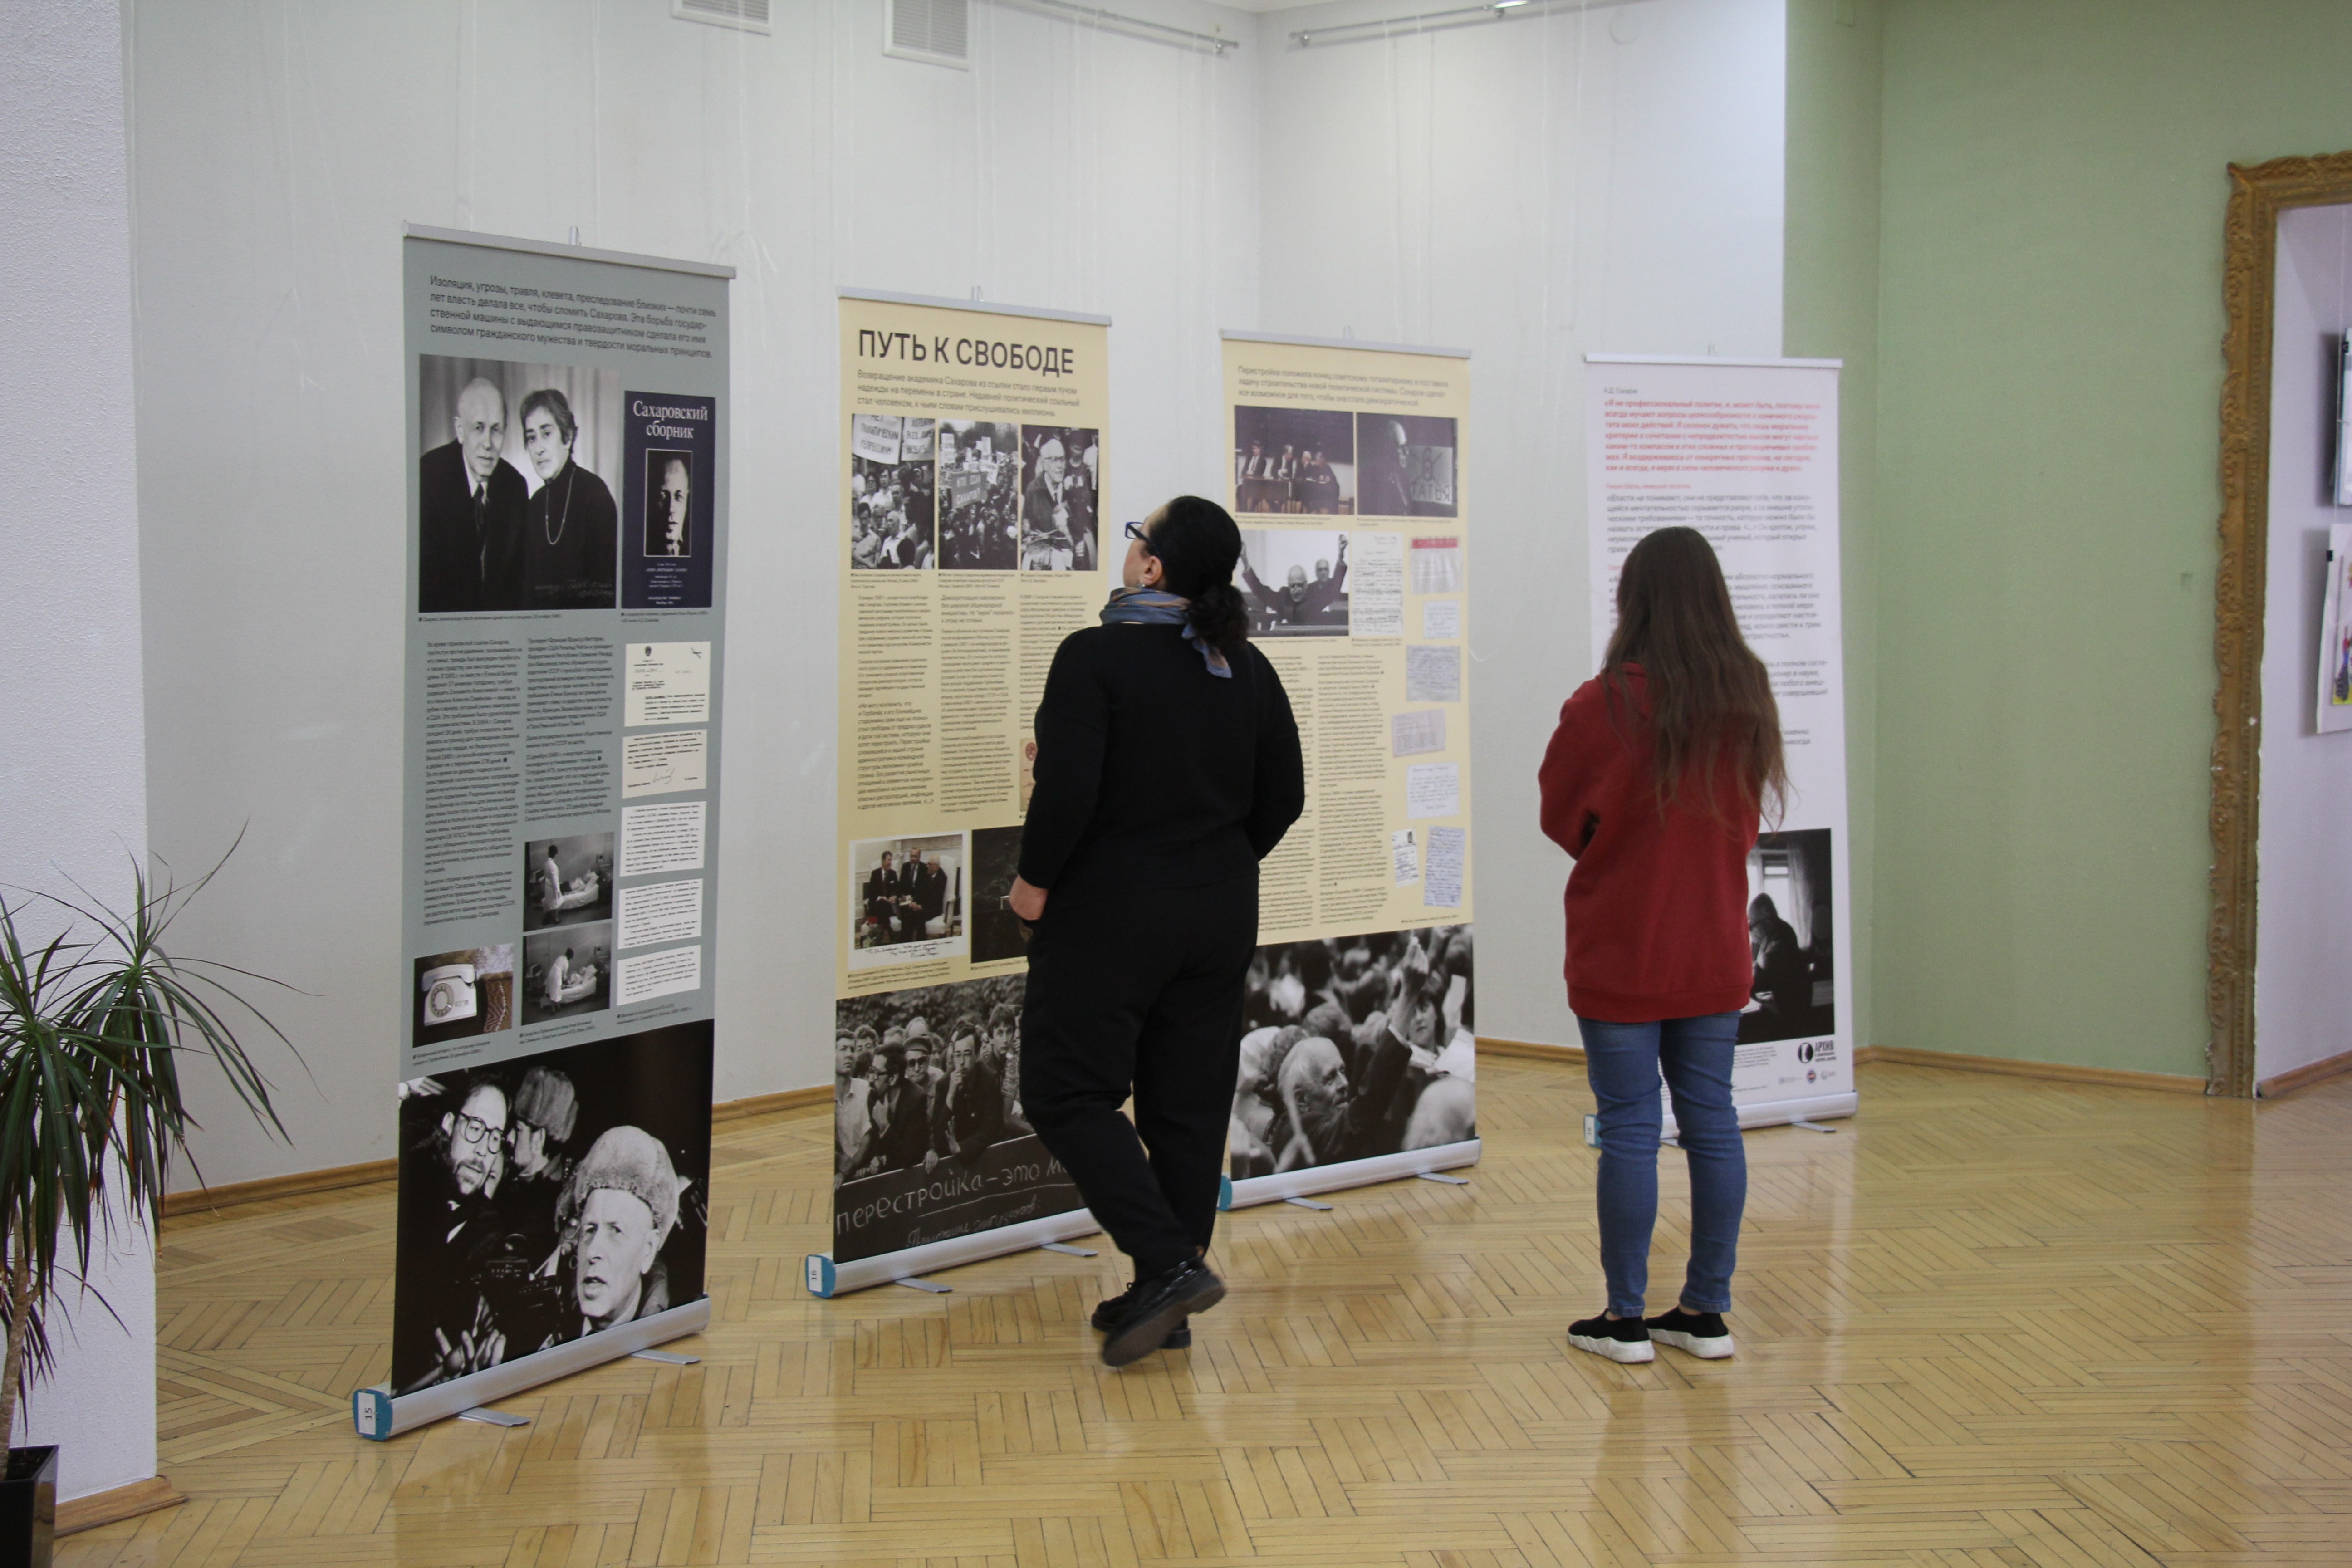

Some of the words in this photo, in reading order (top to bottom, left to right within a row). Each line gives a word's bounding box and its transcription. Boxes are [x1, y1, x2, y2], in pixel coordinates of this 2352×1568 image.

[430, 294, 444, 302] лет
[447, 295, 475, 305] власть
[477, 299, 507, 309] делала
[528, 304, 552, 313] чтобы
[554, 307, 588, 317] сломить
[631, 313, 644, 323] Эта
[646, 315, 672, 327] борьба
[675, 319, 706, 332] государ-
[430, 309, 470, 320] ственной
[473, 314, 508, 323] машины
[517, 318, 571, 330] выдающимся
[573, 323, 644, 337] правозащитником
[646, 331, 676, 340] сделала
[430, 325, 474, 335] символом
[476, 329, 534, 341] гражданского
[537, 335, 575, 345] мужества
[584, 339, 624, 350] твердости
[626, 343, 667, 353] моральных
[859, 329, 926, 361] ПУТЬ
[935, 337, 949, 363] К
[957, 338, 1074, 377] СВОБОДЕ
[633, 400, 708, 421] Сахаровский
[646, 420, 693, 439] сборник
[365, 1407, 372, 1420] 15
